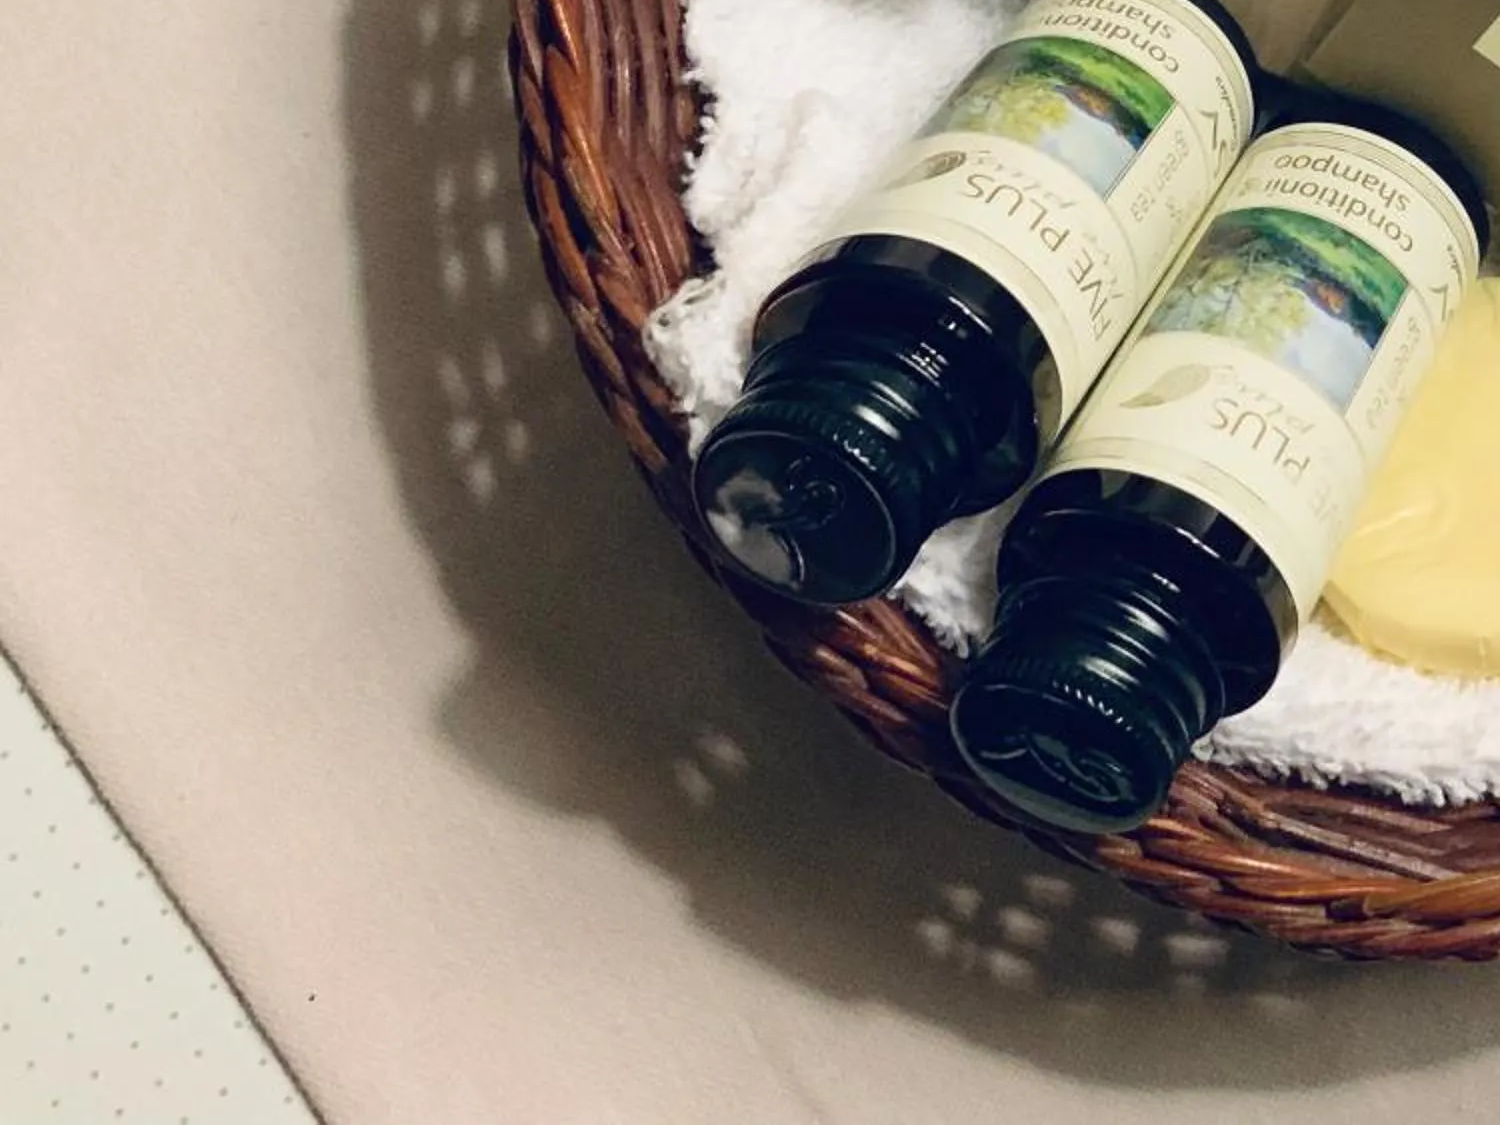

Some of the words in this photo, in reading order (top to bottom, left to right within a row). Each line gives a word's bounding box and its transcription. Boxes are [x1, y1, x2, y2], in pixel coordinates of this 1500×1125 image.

[960, 173, 1071, 253] PLUS
[1273, 153, 1412, 213] shampoo
[1207, 396, 1312, 487] PLUS
